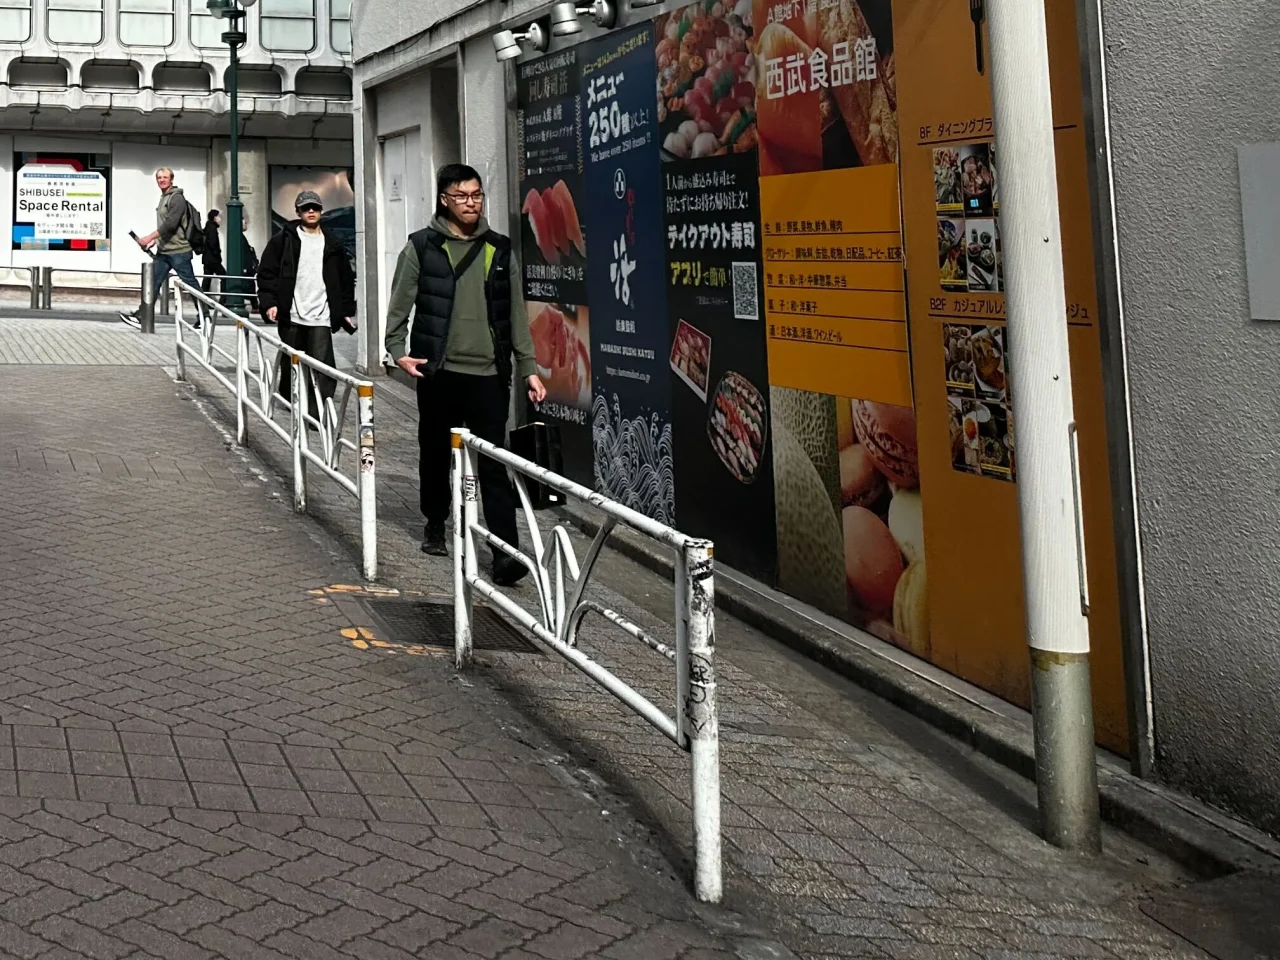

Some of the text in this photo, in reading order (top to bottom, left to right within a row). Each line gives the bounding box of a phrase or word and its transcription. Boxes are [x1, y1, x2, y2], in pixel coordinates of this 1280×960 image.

[766, 35, 878, 100] 西武食品館
[587, 72, 625, 109] メニュー
[19, 188, 65, 197] SHIBUSEI
[19, 199, 103, 213] Space Rental
[668, 221, 756, 249] テイクアウト寿司
[930, 297, 947, 311] B2F
